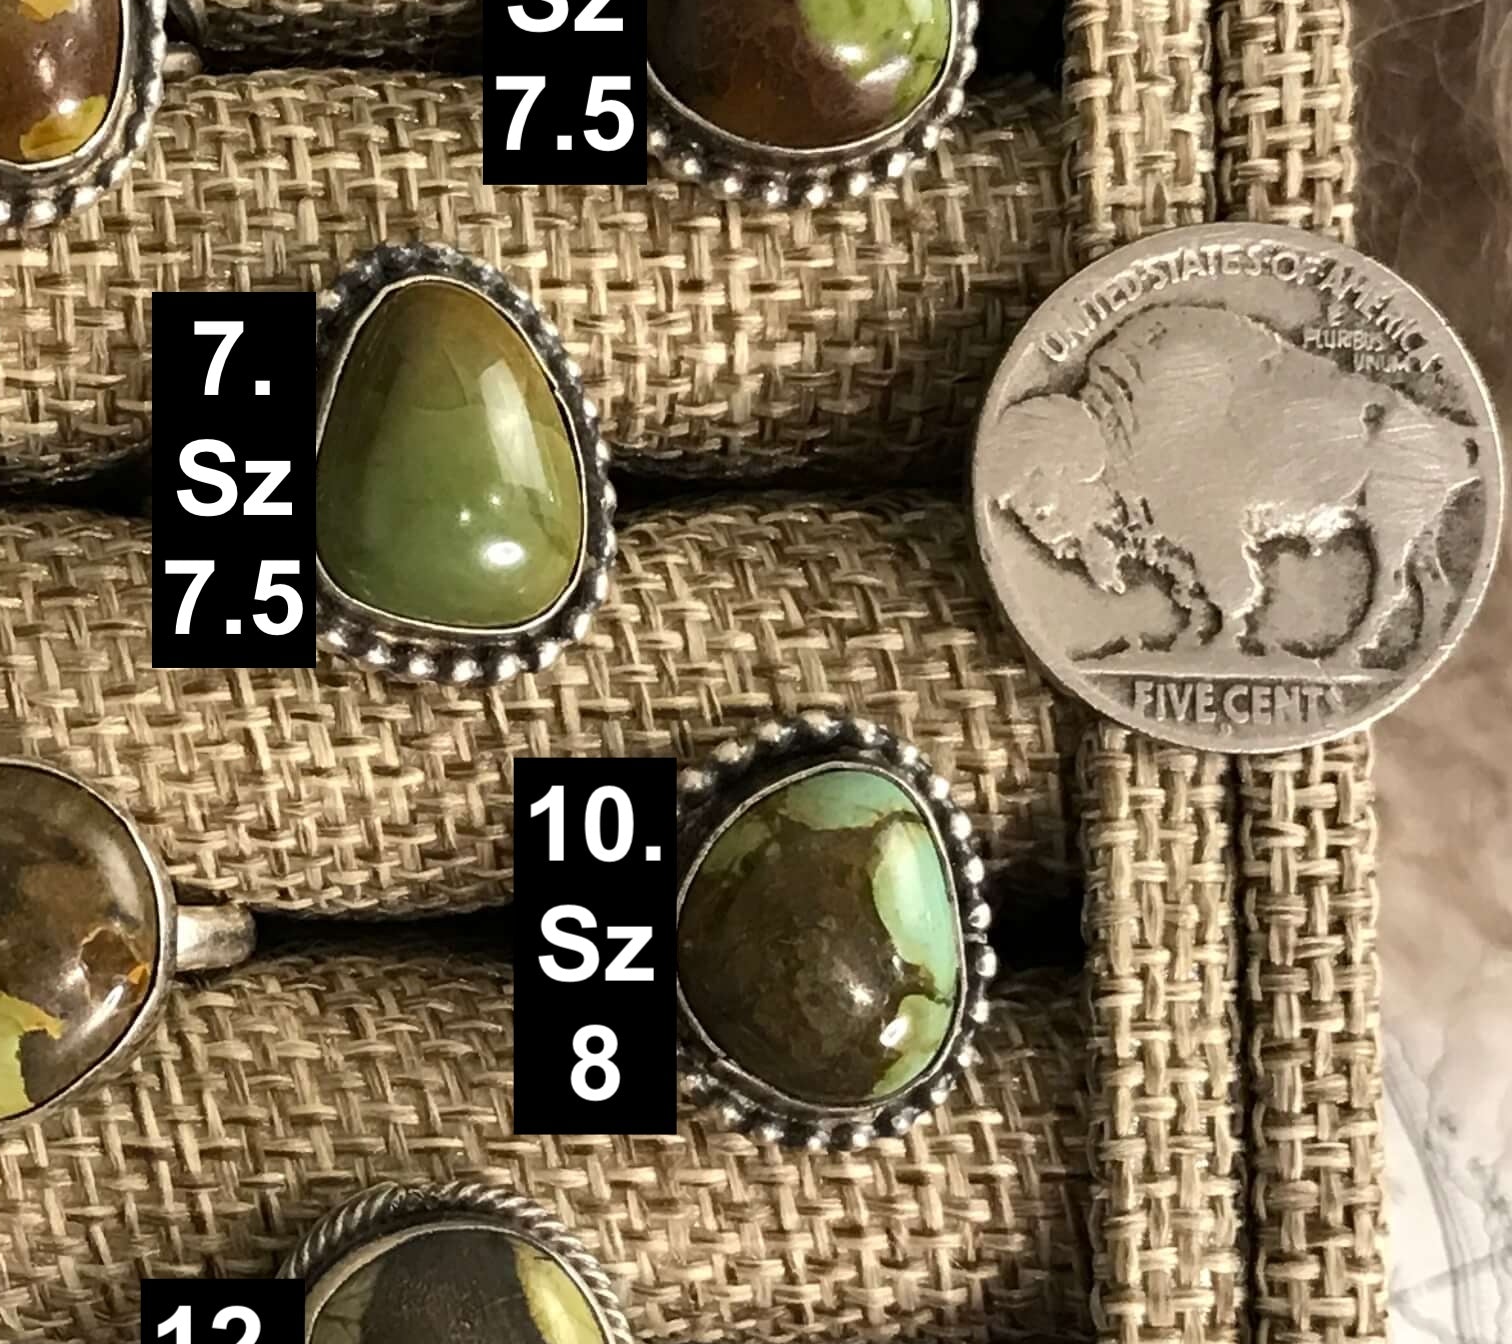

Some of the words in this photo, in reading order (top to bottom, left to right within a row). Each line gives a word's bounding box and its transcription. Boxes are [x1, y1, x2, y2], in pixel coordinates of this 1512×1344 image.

[1039, 265, 1144, 362] UNITED
[1143, 242, 1264, 290] STATES
[1134, 679, 1217, 724] FIVE
